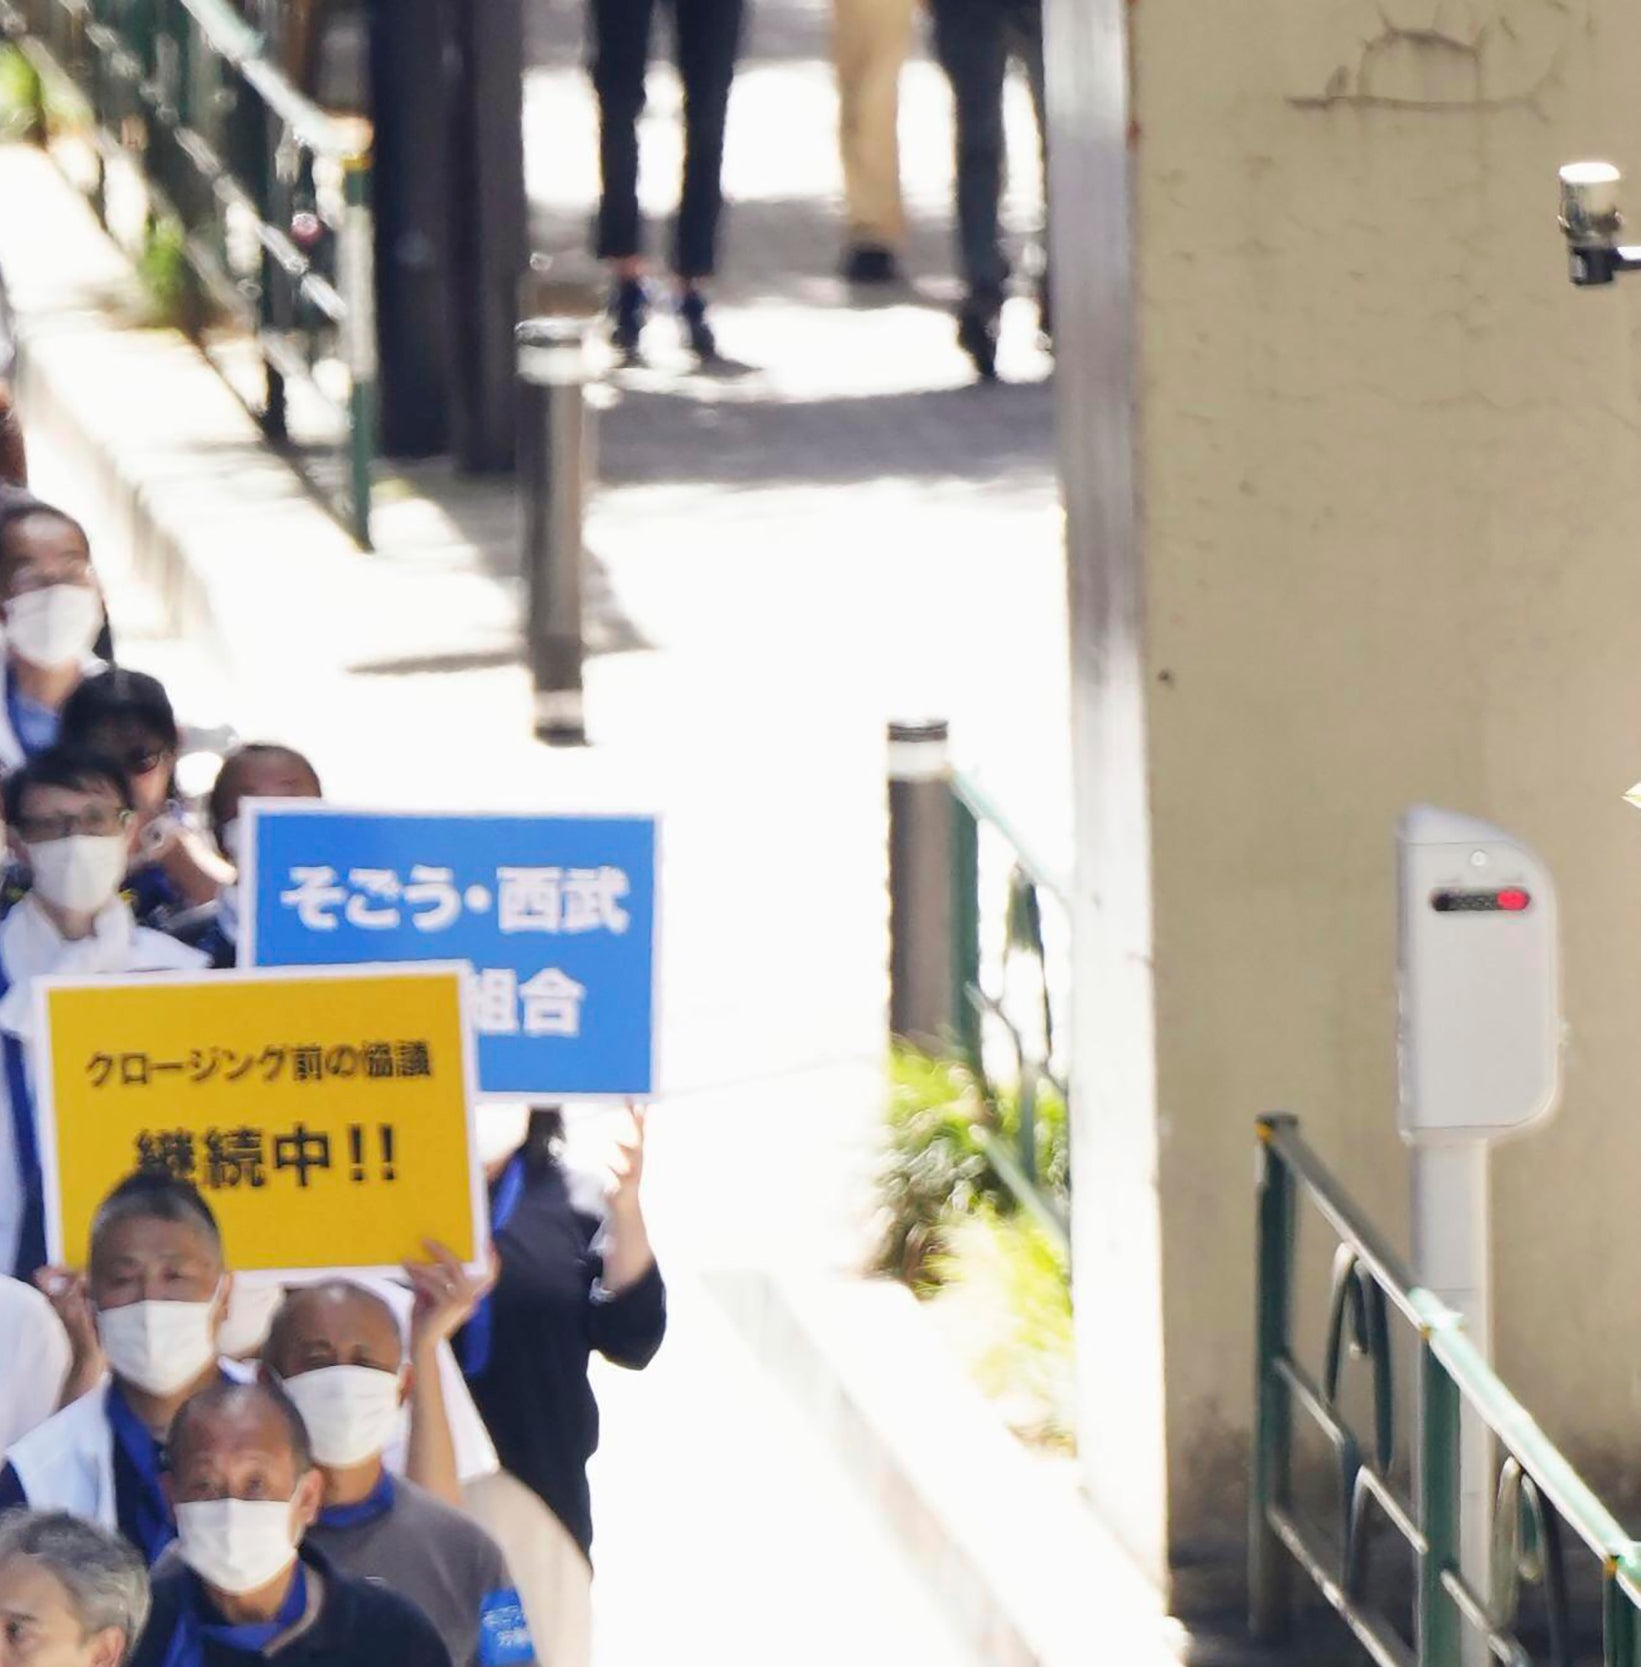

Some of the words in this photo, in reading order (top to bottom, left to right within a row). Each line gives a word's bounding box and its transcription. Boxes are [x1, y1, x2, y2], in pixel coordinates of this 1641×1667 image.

[280, 865, 631, 934] そごう・西武
[86, 1040, 431, 1088] クロージング前の協議
